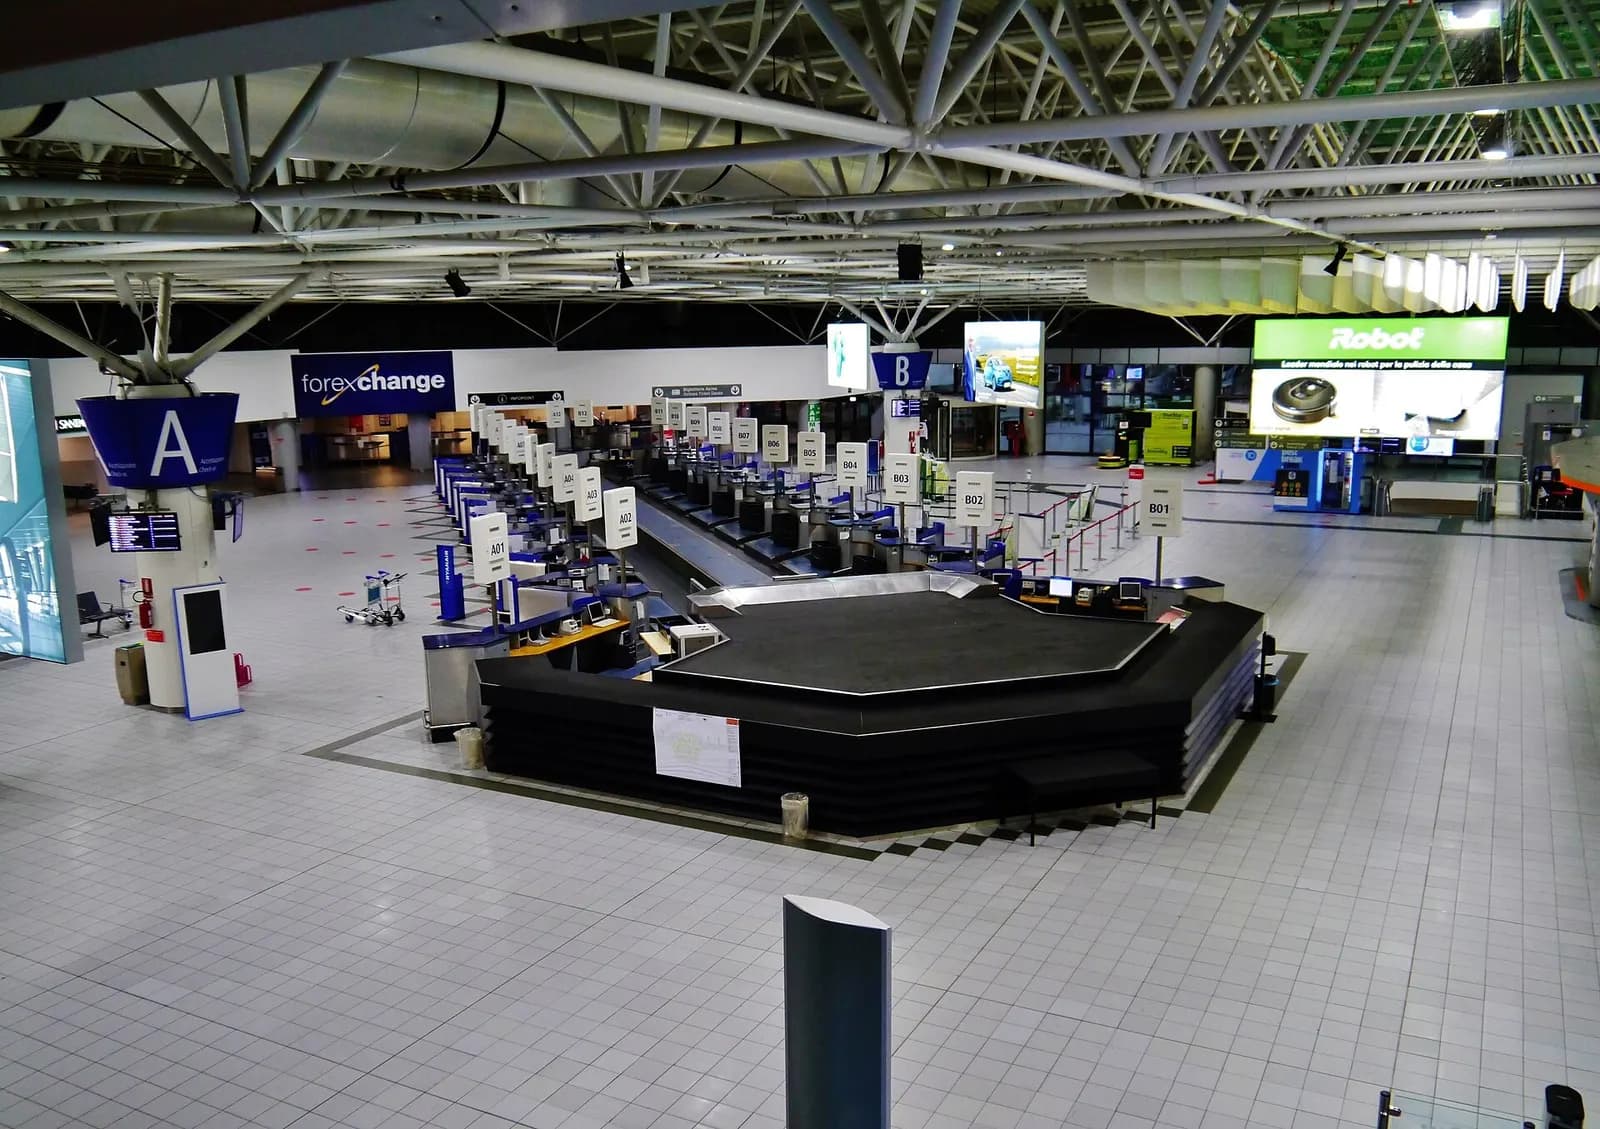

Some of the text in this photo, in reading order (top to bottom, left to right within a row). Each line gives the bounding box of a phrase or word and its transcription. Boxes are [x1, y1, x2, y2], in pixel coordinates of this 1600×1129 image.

[1357, 360, 1379, 368] robot
[1379, 361, 1394, 370] per
[895, 356, 909, 387] B
[302, 371, 445, 393] forexchange
[150, 410, 198, 476] A
[803, 449, 816, 457] B05
[843, 461, 858, 469] B04
[893, 474, 909, 483] B03
[587, 489, 598, 500] A03
[965, 495, 983, 505] B02
[1149, 503, 1169, 514] B01
[619, 512, 632, 524] A02
[490, 542, 505, 556] A01
